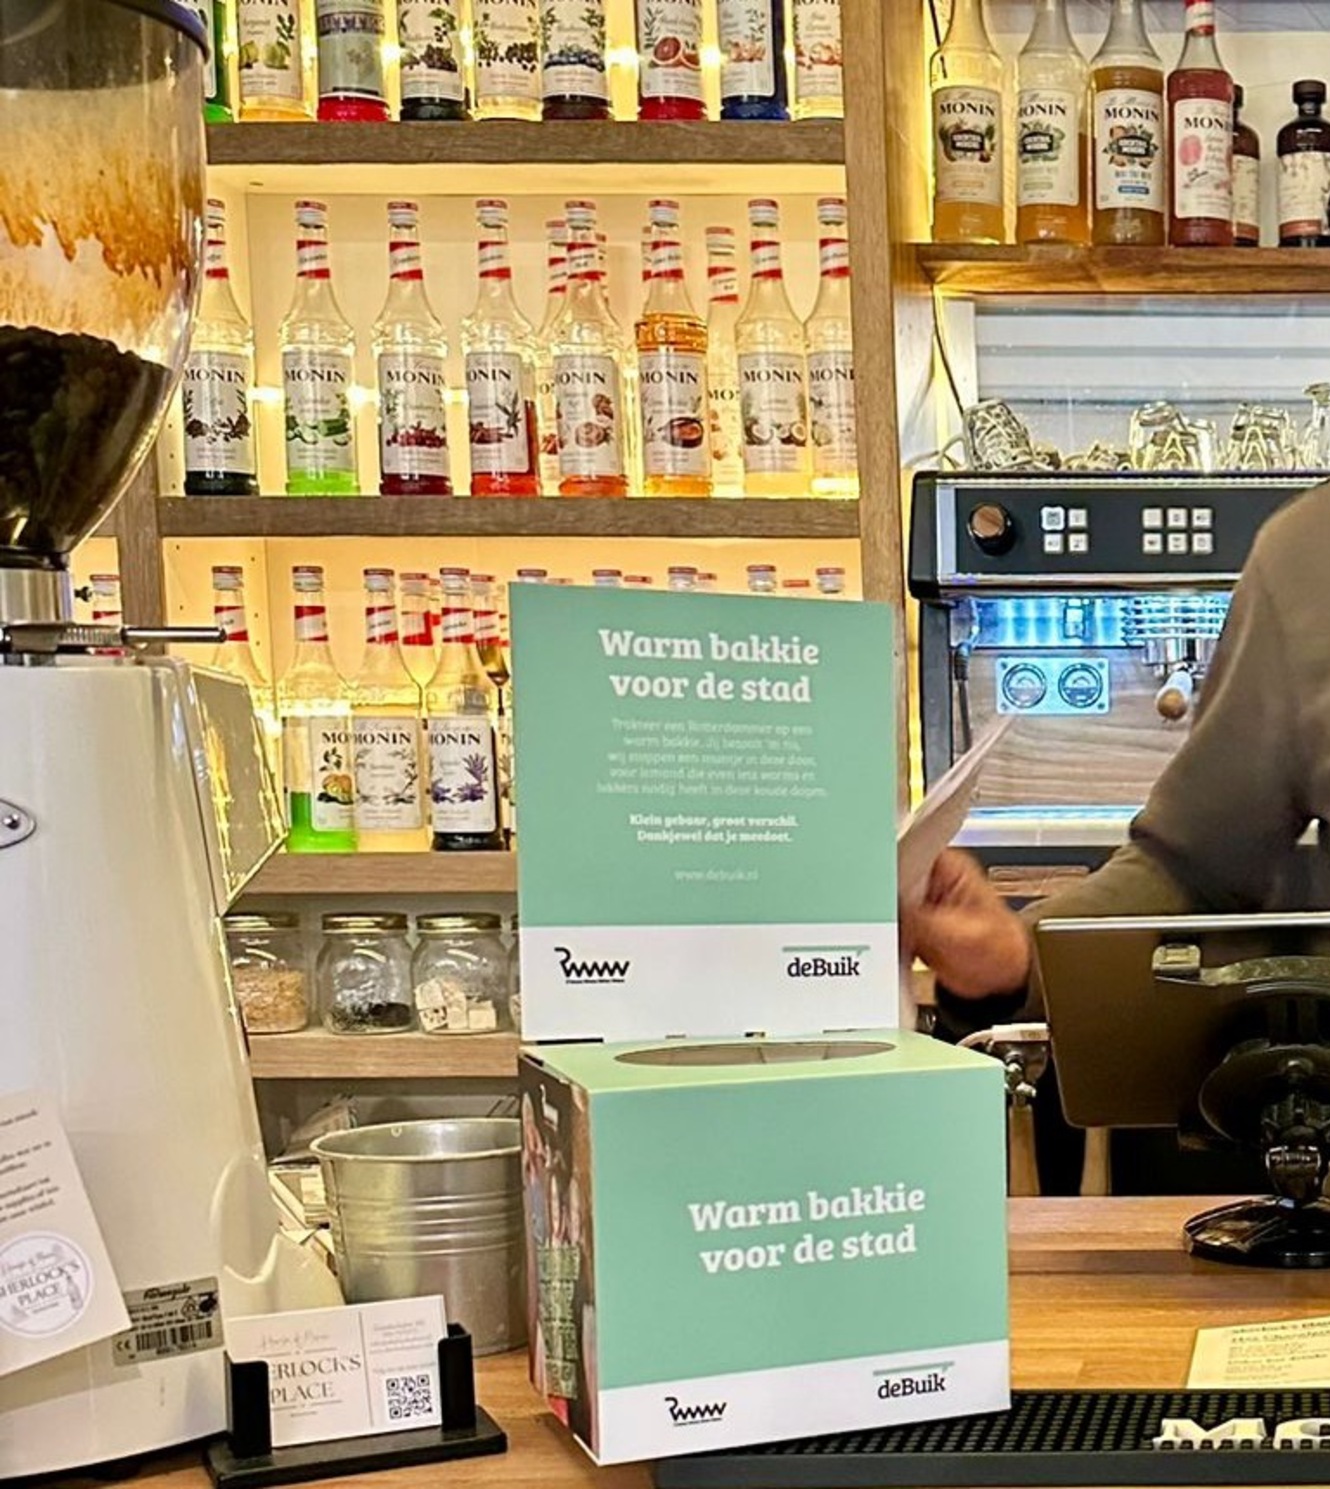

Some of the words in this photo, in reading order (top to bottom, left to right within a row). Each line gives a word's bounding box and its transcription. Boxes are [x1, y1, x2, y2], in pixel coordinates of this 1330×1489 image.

[940, 102, 995, 117] MONIN
[1104, 107, 1160, 121] MONIN
[1185, 117, 1225, 129] MON
[185, 369, 245, 383] MONIN
[285, 369, 345, 382] MONIN
[467, 369, 512, 381] ONIN
[557, 372, 606, 385] ONIN
[743, 370, 802, 382] MONIN
[811, 369, 855, 381] MONI
[598, 628, 702, 660] Warm
[709, 633, 820, 665] bakkie
[609, 674, 690, 699] voor
[696, 671, 735, 701] de
[741, 675, 811, 702] stad
[629, 814, 662, 825] Klein
[665, 814, 711, 828] gebaar,
[713, 815, 745, 829] groot
[747, 814, 799, 827] verschil.
[637, 829, 702, 844] Dankjewel
[704, 829, 724, 843] dat
[725, 829, 737, 845] je
[739, 829, 793, 843] meedoet.
[787, 957, 860, 978] deBuik
[688, 1200, 801, 1231] Warm
[808, 1184, 925, 1221] bakkie
[700, 1242, 785, 1274] voor
[793, 1233, 834, 1264] de
[842, 1224, 917, 1259] stad
[270, 1355, 361, 1380] ERLOCK'S
[270, 1381, 334, 1405] PLACE
[877, 1374, 946, 1400] deBuik
